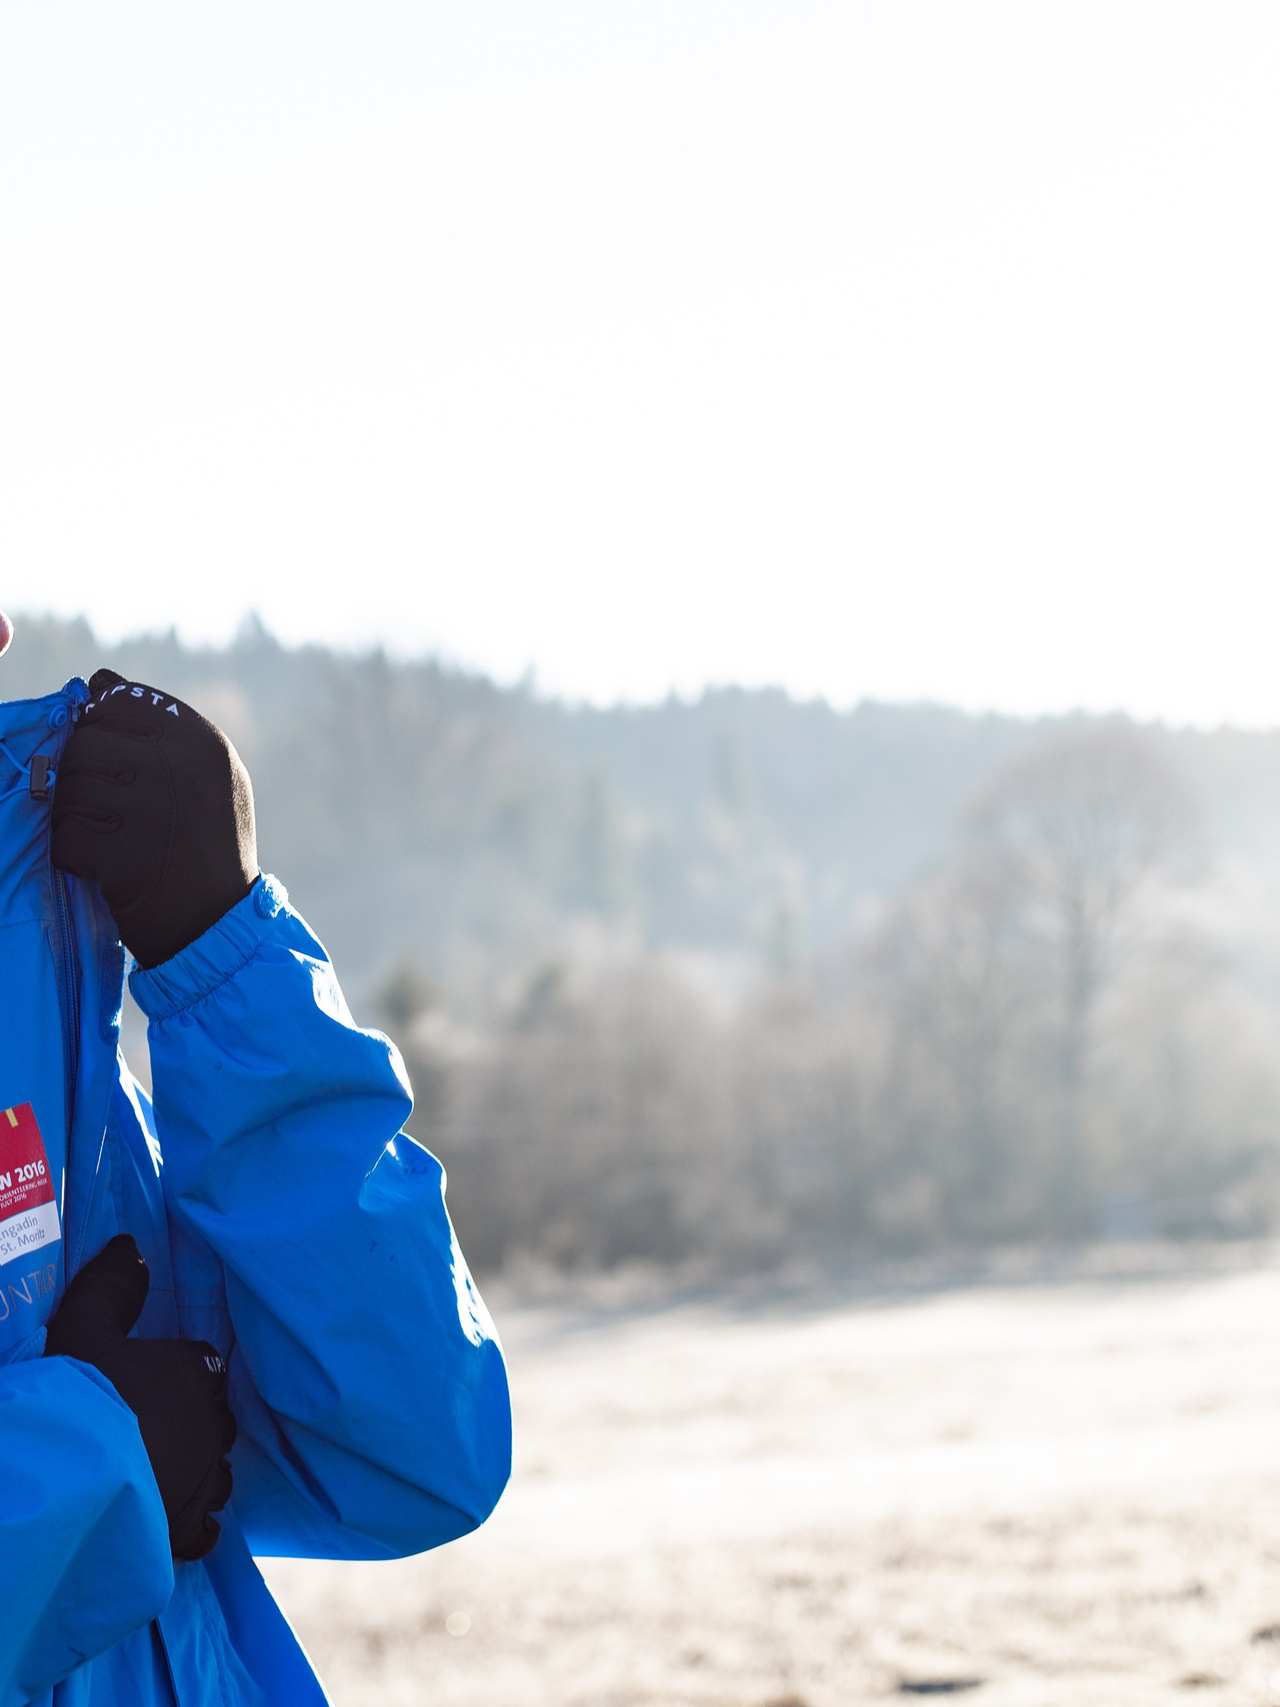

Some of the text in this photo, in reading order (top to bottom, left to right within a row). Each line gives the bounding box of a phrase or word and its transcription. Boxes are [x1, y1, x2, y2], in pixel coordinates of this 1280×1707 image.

[14, 1159, 45, 1183] 2016
[13, 1193, 27, 1204] 2016
[0, 1228, 45, 1256] St. Moritz
